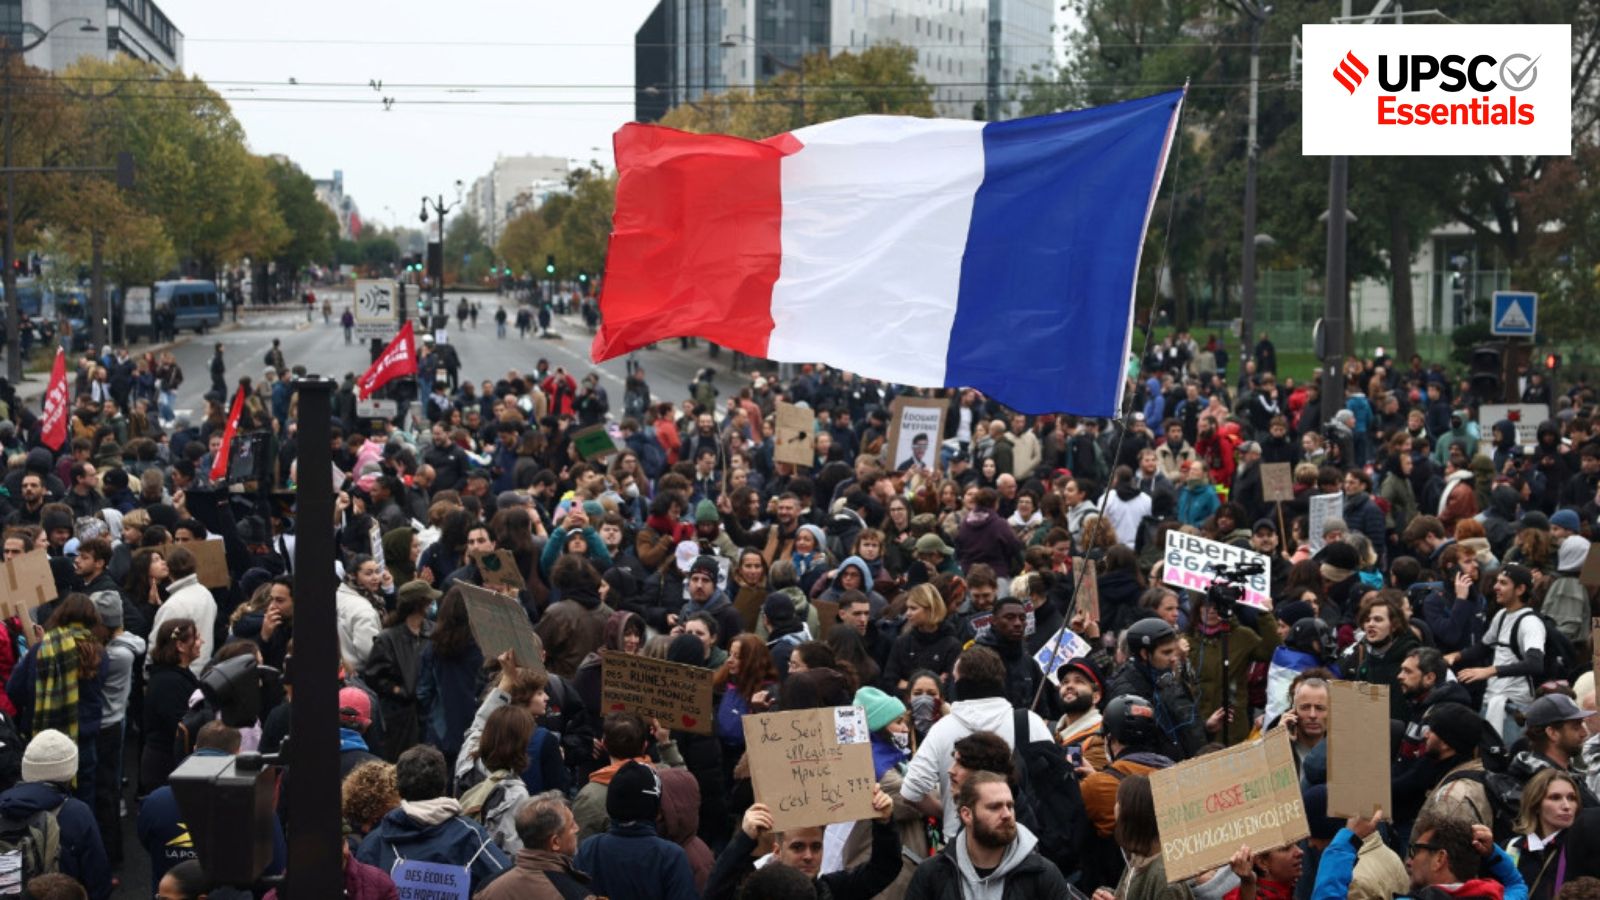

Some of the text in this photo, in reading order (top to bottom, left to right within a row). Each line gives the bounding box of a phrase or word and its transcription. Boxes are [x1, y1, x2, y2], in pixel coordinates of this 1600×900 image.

[606, 670, 624, 680] DES
[657, 687, 695, 704] MONDE
[790, 719, 823, 743] Seul
[1205, 784, 1244, 814] CASSE
[165, 850, 178, 859] LA
[404, 869, 422, 882] DES
